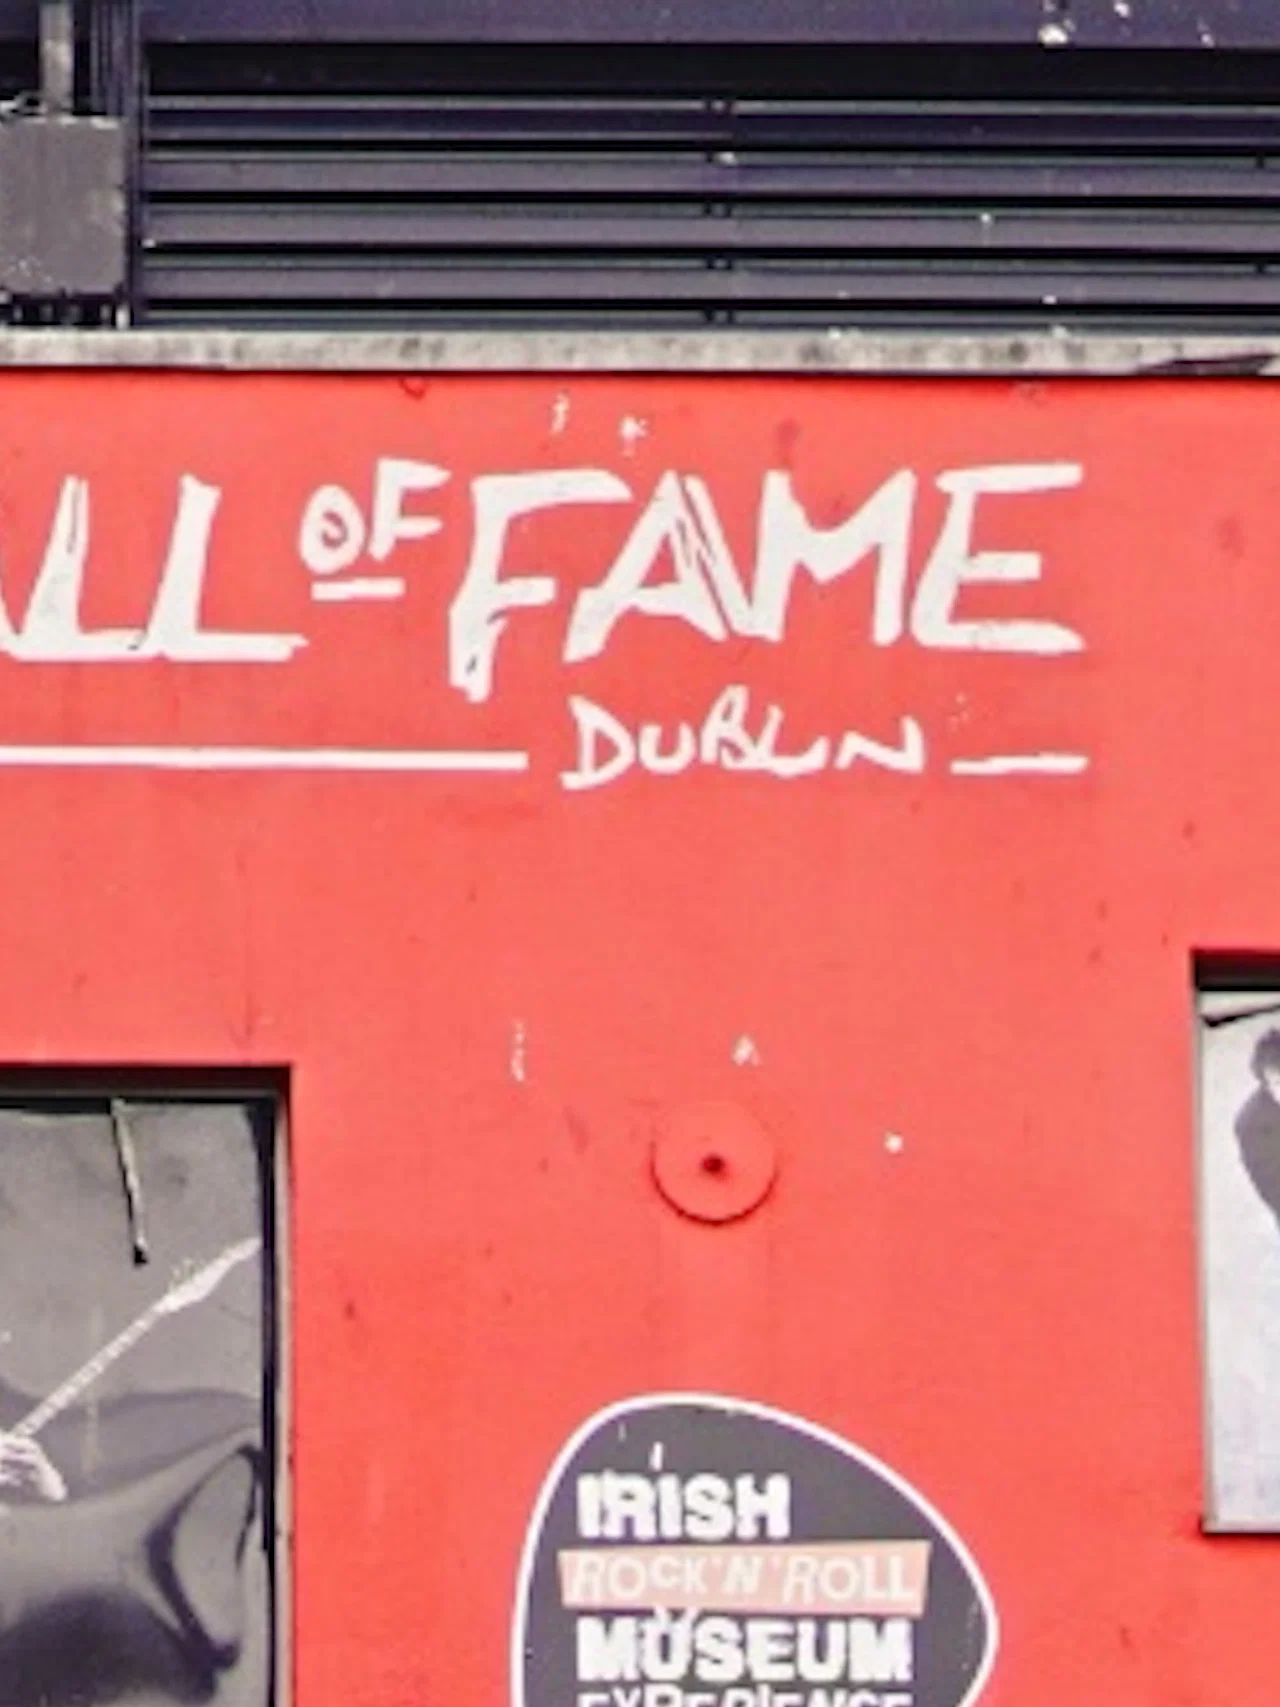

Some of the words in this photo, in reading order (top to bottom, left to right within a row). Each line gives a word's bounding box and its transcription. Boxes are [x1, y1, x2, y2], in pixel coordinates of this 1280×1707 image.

[297, 457, 450, 602] OF
[446, 461, 1084, 702] FAME
[560, 684, 926, 790] DUBLIN
[576, 1473, 791, 1539] IRISH
[576, 1615, 914, 1682] MUSEUM
